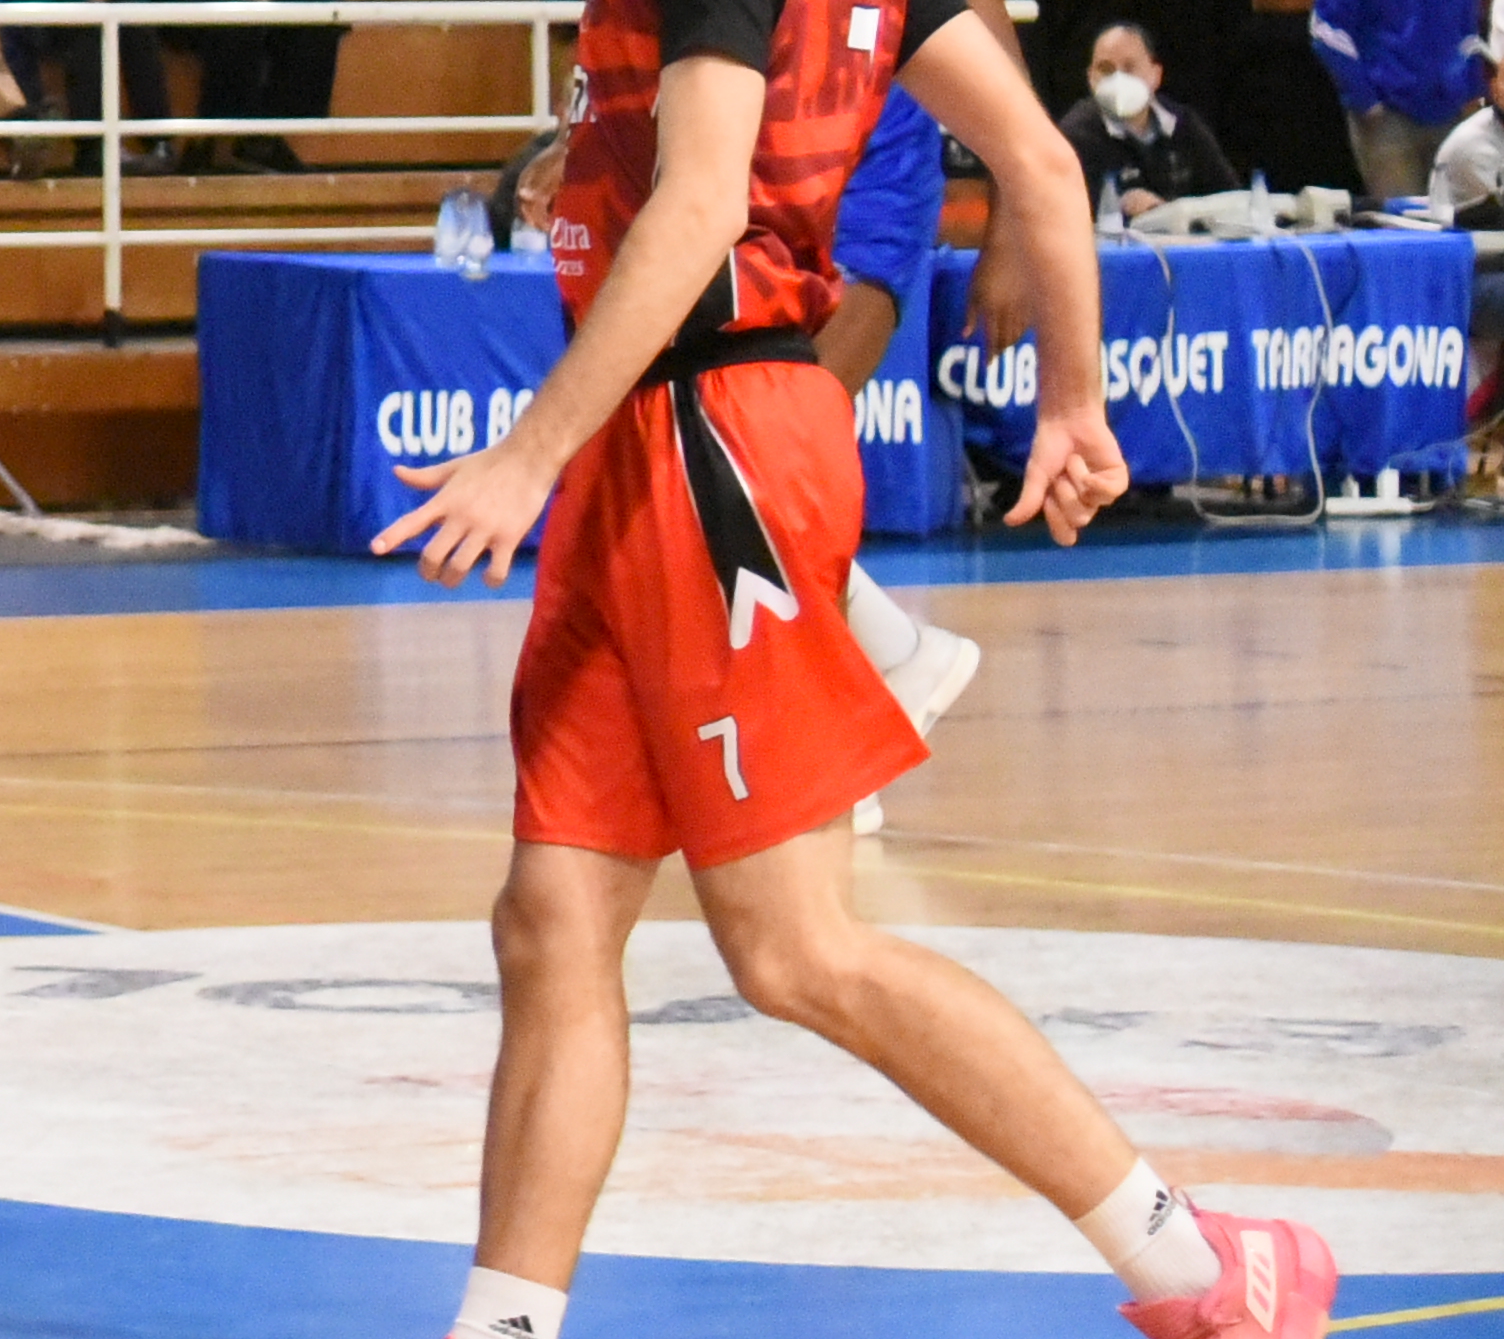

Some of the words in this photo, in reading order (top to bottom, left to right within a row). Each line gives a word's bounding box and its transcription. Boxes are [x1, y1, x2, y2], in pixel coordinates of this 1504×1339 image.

[938, 342, 1037, 408] CLUB
[1250, 325, 1463, 391] TARRAGONA
[377, 389, 475, 457] CLUB
[696, 715, 751, 802] 7
